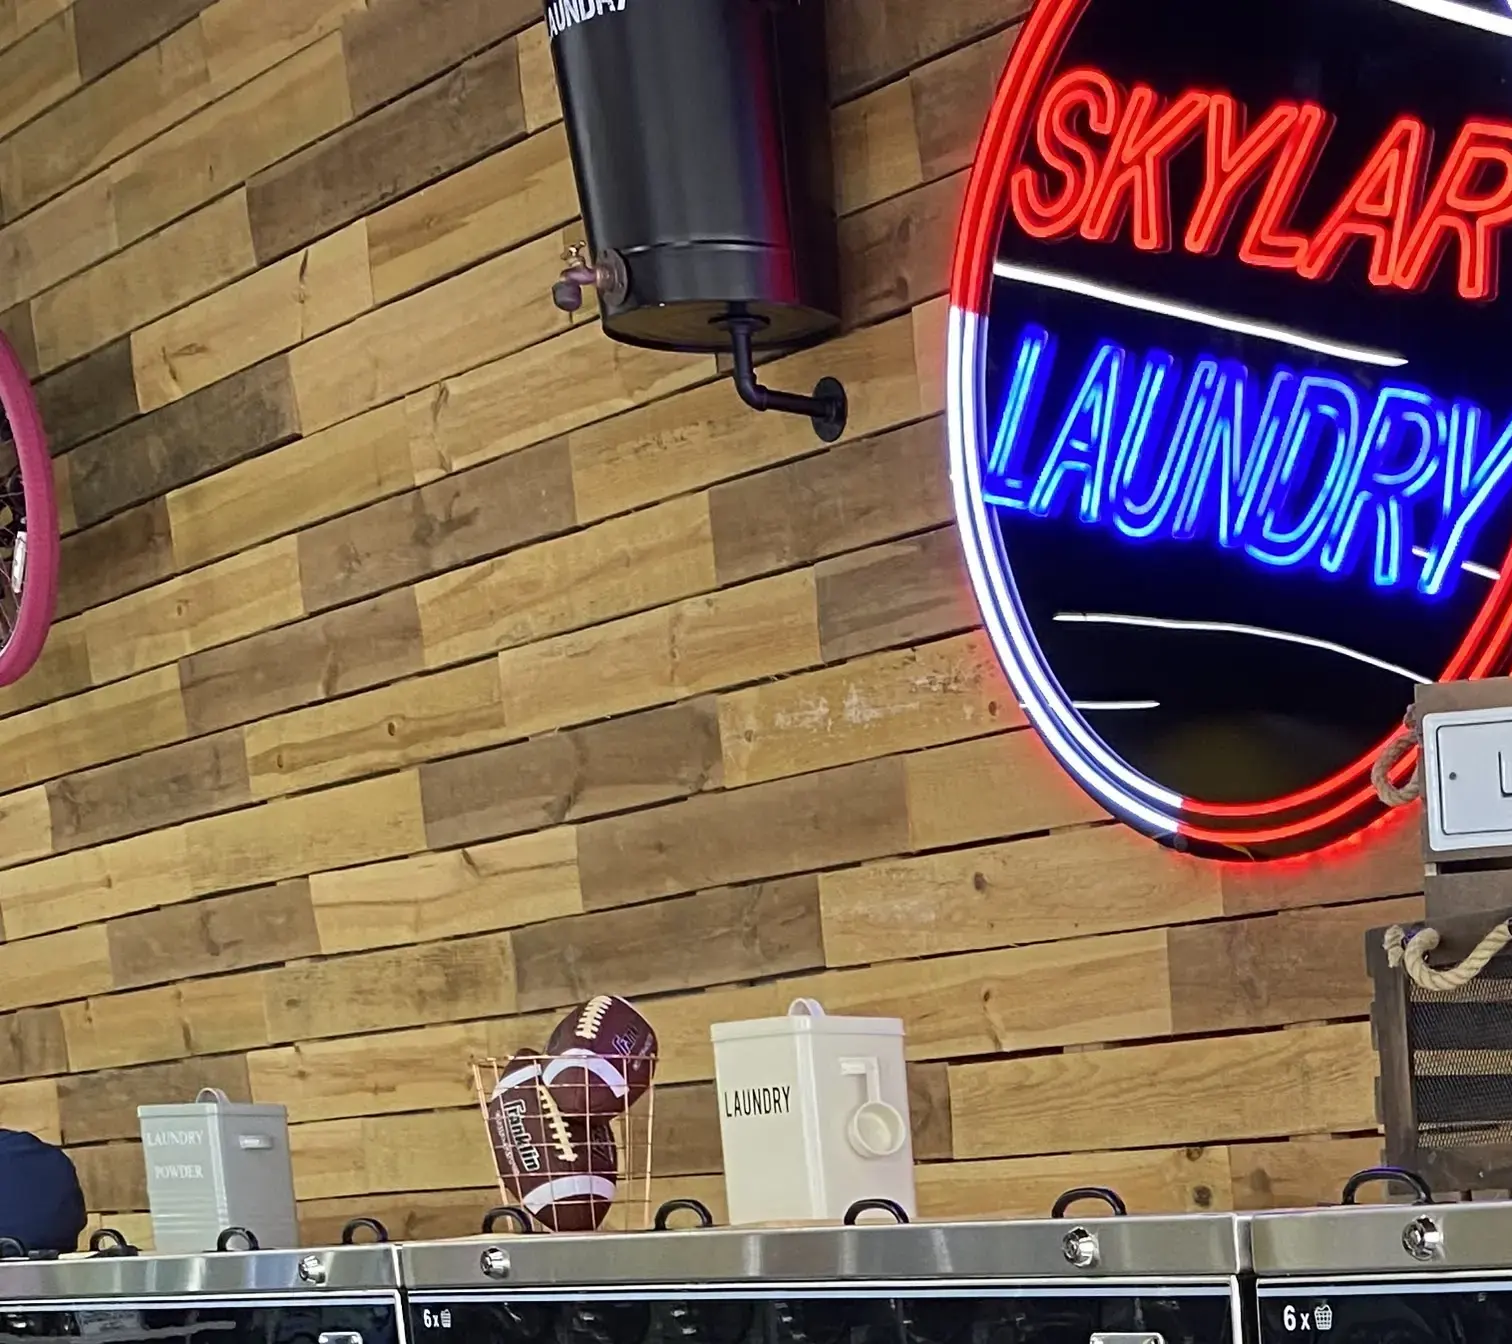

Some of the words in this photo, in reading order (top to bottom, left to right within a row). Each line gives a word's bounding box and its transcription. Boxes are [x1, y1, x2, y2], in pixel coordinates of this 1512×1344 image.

[725, 1086, 790, 1118] LAUNDRY
[146, 1130, 204, 1147] LAUNDRY
[154, 1164, 204, 1179] POWDER
